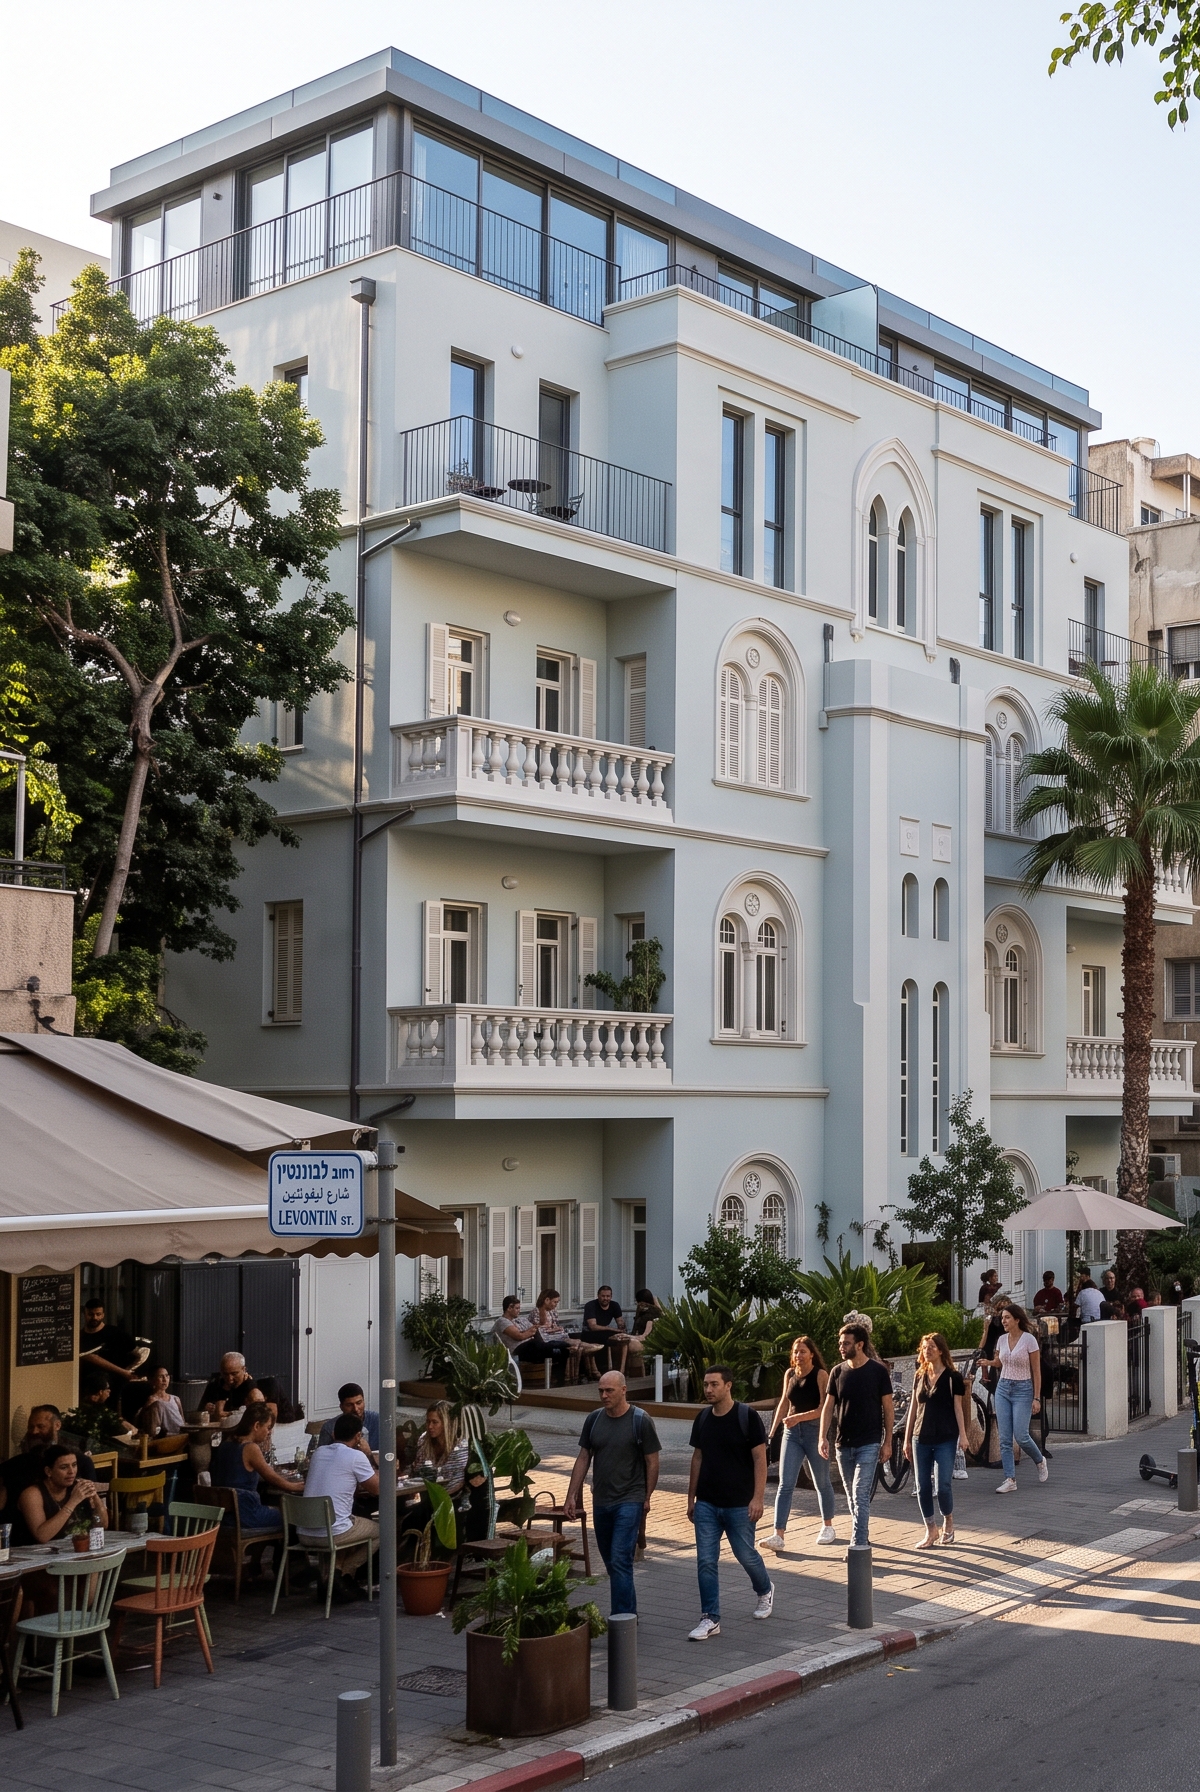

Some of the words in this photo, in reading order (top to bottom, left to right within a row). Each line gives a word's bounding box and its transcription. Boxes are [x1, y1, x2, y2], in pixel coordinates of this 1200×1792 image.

[331, 1167, 355, 1180] רחוב
[326, 1187, 350, 1205] شارع
[278, 1209, 338, 1226] LEVONTIN
[340, 1215, 354, 1226] ST.
